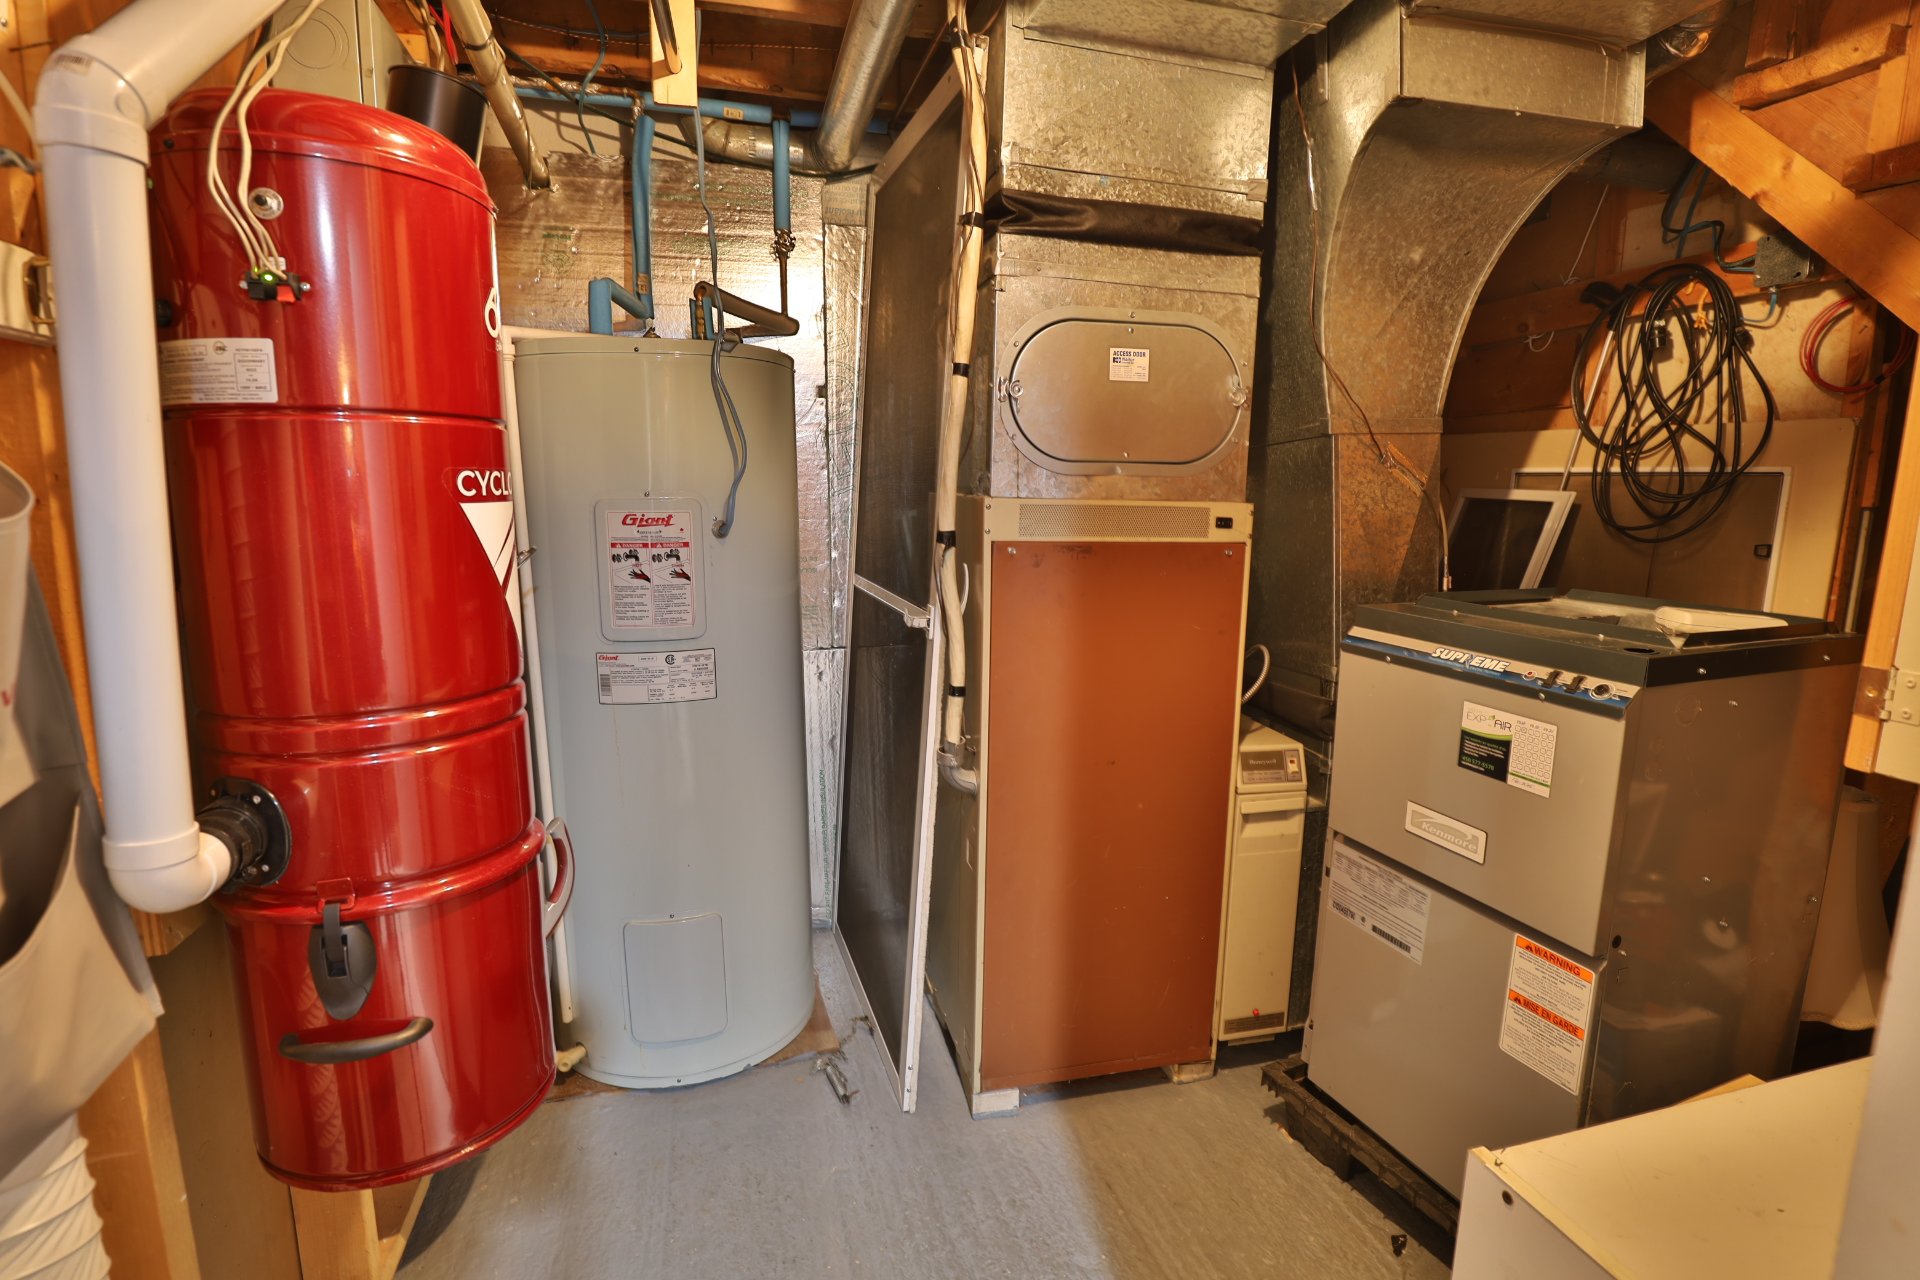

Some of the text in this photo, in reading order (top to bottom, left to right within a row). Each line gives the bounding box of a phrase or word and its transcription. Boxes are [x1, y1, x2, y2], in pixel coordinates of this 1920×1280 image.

[621, 513, 675, 528] Giant
[1493, 719, 1512, 733] AIR
[1421, 821, 1477, 851] Kenmore
[1533, 945, 1581, 977] WARNING
[1523, 999, 1580, 1037] MISE EN GARDE
